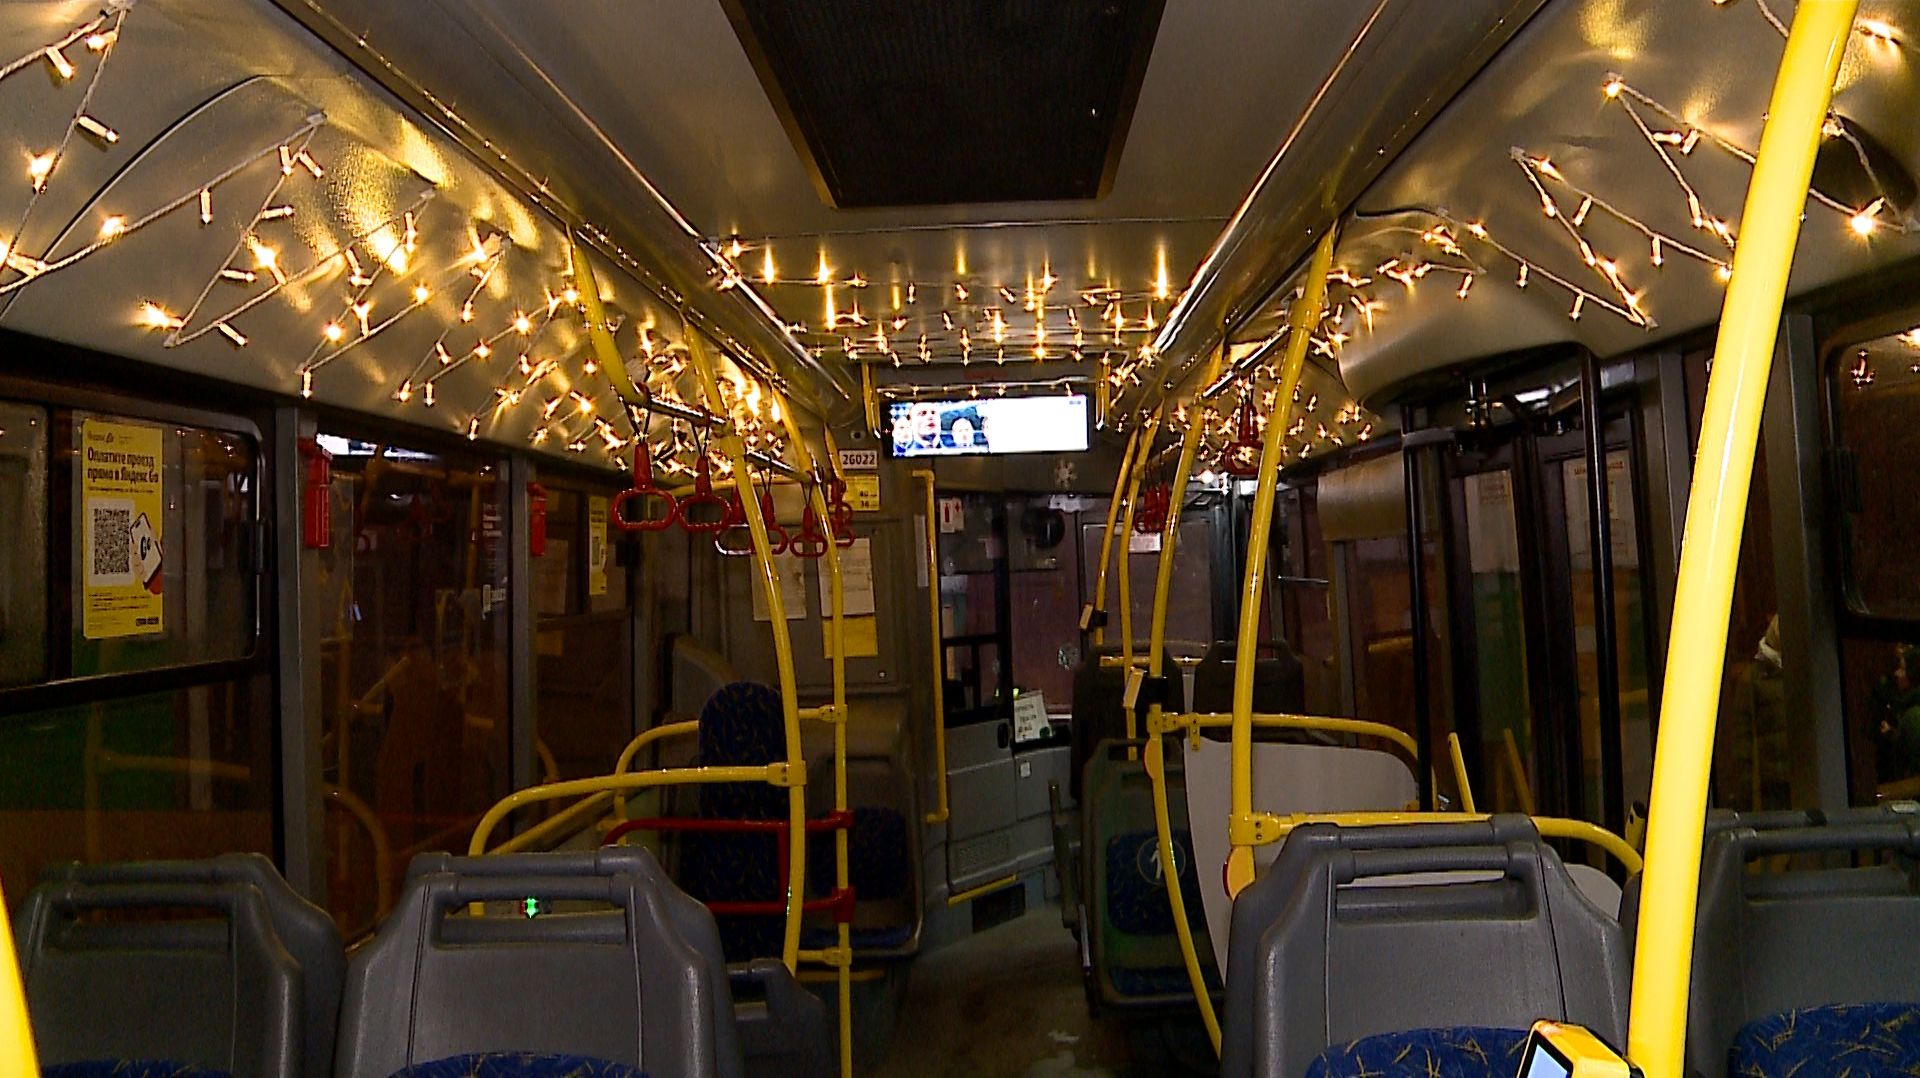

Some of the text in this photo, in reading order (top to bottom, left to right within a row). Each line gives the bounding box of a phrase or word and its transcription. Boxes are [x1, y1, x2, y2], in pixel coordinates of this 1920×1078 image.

[88, 447, 155, 470] Оплатите проезд
[842, 454, 876, 465] 26022
[88, 468, 113, 482] прямо
